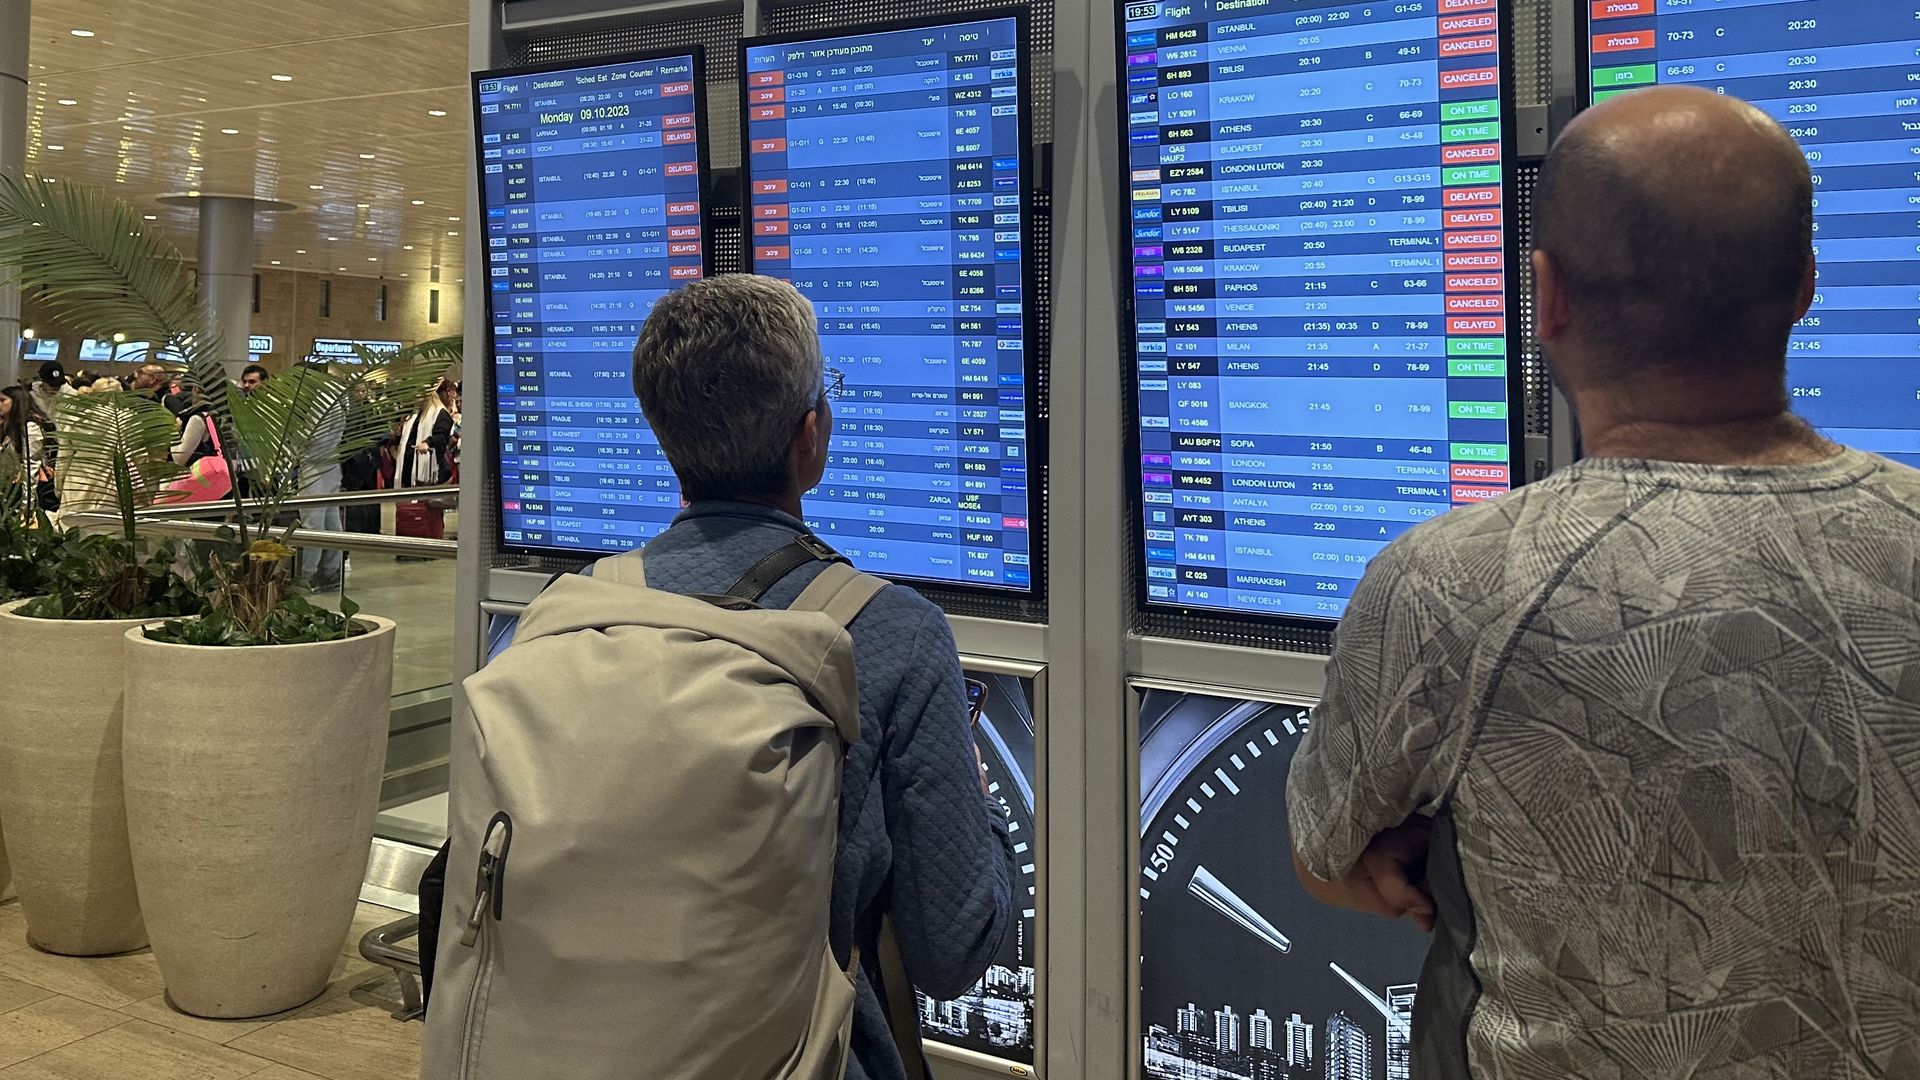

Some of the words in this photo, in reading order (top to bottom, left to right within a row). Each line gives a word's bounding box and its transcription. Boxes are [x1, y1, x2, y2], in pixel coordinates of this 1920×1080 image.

[1130, 5, 1155, 17] 19:53
[1166, 7, 1190, 18] Flight
[1216, 0, 1269, 11] Destination
[1607, 3, 1638, 12] מבוטלת
[1166, 32, 1177, 40] HM
[1217, 23, 1256, 34] ISTANBUL
[1328, 12, 1349, 21] 22:00
[1395, 3, 1422, 13] G1-G5
[1788, 18, 1816, 31] 20:20
[960, 33, 978, 42] טיסה
[1667, 30, 1694, 42] 70-73
[1716, 28, 1724, 37] C
[922, 38, 934, 46] יעד
[1608, 36, 1639, 46] מבוטלת
[1218, 65, 1244, 74] TBILISI
[1299, 57, 1321, 67] 20:10
[1398, 47, 1420, 56] 49-51
[1443, 39, 1492, 51] CANCELED
[1788, 55, 1816, 66] 20:30
[1668, 65, 1694, 76] 66-69
[1716, 62, 1724, 72] C
[503, 84, 518, 93] Flight
[533, 79, 564, 89] Destination
[598, 74, 607, 82] Est
[611, 72, 626, 80] Zone
[630, 69, 653, 79] Counter
[661, 66, 688, 75] Remarks
[1789, 79, 1817, 90] 20:30
[664, 84, 688, 93] DELAYED
[1219, 94, 1255, 104] KRAKOW
[1444, 72, 1493, 84] CANCELED
[1131, 95, 1148, 104] LOT
[1789, 103, 1817, 114] 20:30
[540, 111, 574, 124] Monday
[581, 105, 629, 120] 09.10.2023
[1220, 125, 1252, 134] ATHENS
[1300, 118, 1322, 127] 20:30
[1366, 114, 1373, 122] C
[1400, 110, 1422, 119] 66-69
[1467, 105, 1488, 114] TIME
[666, 116, 690, 125] DELAYED
[1790, 127, 1817, 137] 20:40
[668, 164, 692, 172] DELAYED
[1170, 169, 1185, 177] EZY
[1221, 163, 1255, 173] LONDON
[1257, 162, 1284, 171] LUTON
[1301, 159, 1323, 168] 20:30
[1446, 148, 1495, 159] CANCELED
[1171, 207, 1181, 215] LY
[1222, 205, 1248, 213] TBILISI
[1300, 200, 1327, 210] (20:40)
[1332, 199, 1354, 208] 21:20
[1402, 195, 1425, 203] 78-99
[1451, 192, 1492, 201] DELAYED
[1223, 223, 1279, 233] THESSALONIKI
[1451, 213, 1493, 223] DELAYED
[1185, 285, 1197, 293] 591
[1225, 284, 1257, 292] PAPHOS
[1305, 281, 1326, 291] 21:15
[1404, 280, 1426, 288] 63-66
[1449, 278, 1498, 287] CANCELED
[316, 342, 352, 353] Departures
[1793, 342, 1821, 350] 21:45
[1188, 362, 1201, 370] 547
[1227, 362, 1259, 370] ATHENS
[1308, 362, 1329, 371] 21:45
[1374, 363, 1380, 371] D
[1407, 363, 1429, 372] 78-99
[1457, 363, 1471, 371] ON
[1473, 363, 1494, 372] TIME
[1793, 388, 1821, 396] 21:45
[1229, 401, 1268, 409] BANGKOK
[1180, 438, 1194, 446] LAU
[1231, 440, 1255, 448] SOFIA
[1311, 443, 1332, 451] 21:50
[1409, 446, 1432, 454] 46-48
[1460, 448, 1474, 456] ON
[1475, 448, 1497, 456] TIME
[1195, 477, 1211, 485] 4452
[1232, 479, 1266, 488] LONDON
[1268, 481, 1295, 489] LUTON
[1312, 483, 1333, 491] 21:55
[1397, 487, 1440, 496] TERMINAL
[929, 496, 951, 504] ZARQA
[1183, 514, 1197, 522] AYT
[1234, 518, 1265, 526] ATHENS
[1314, 523, 1335, 531] 22:00
[1237, 576, 1285, 586] MARRAKESH
[1316, 582, 1337, 591] 22:00
[1149, 842, 1174, 873] 50
